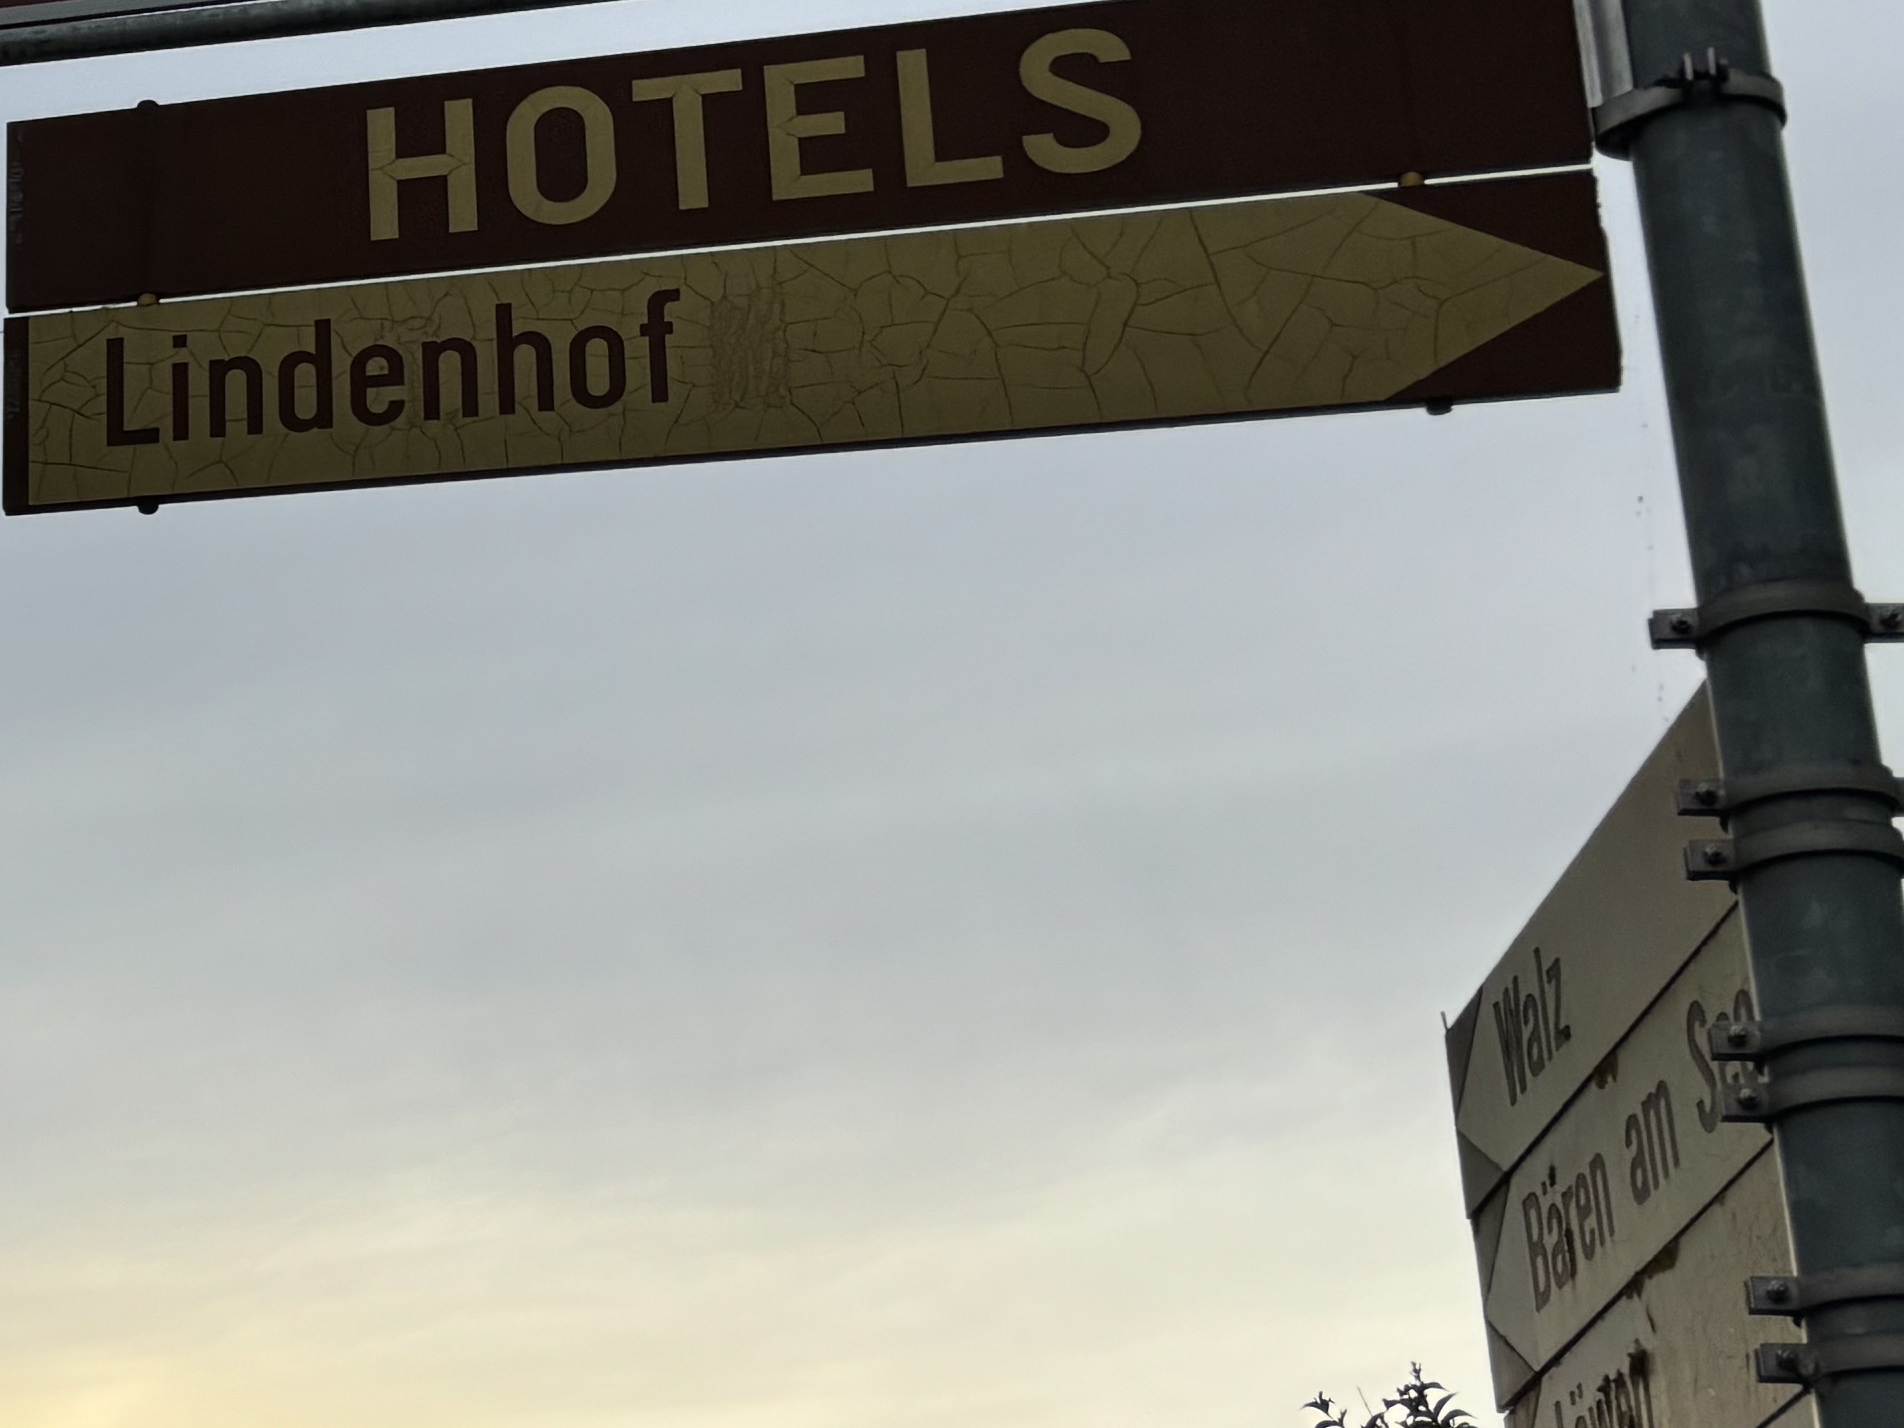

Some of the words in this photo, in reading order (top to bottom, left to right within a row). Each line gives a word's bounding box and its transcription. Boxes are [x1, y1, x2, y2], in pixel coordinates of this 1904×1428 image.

[367, 29, 1141, 240] HOTELS
[106, 288, 680, 447] Lindenhof
[1493, 947, 1572, 1107] Walz
[1522, 1165, 1615, 1313] Bären
[1625, 1080, 1679, 1205] am
